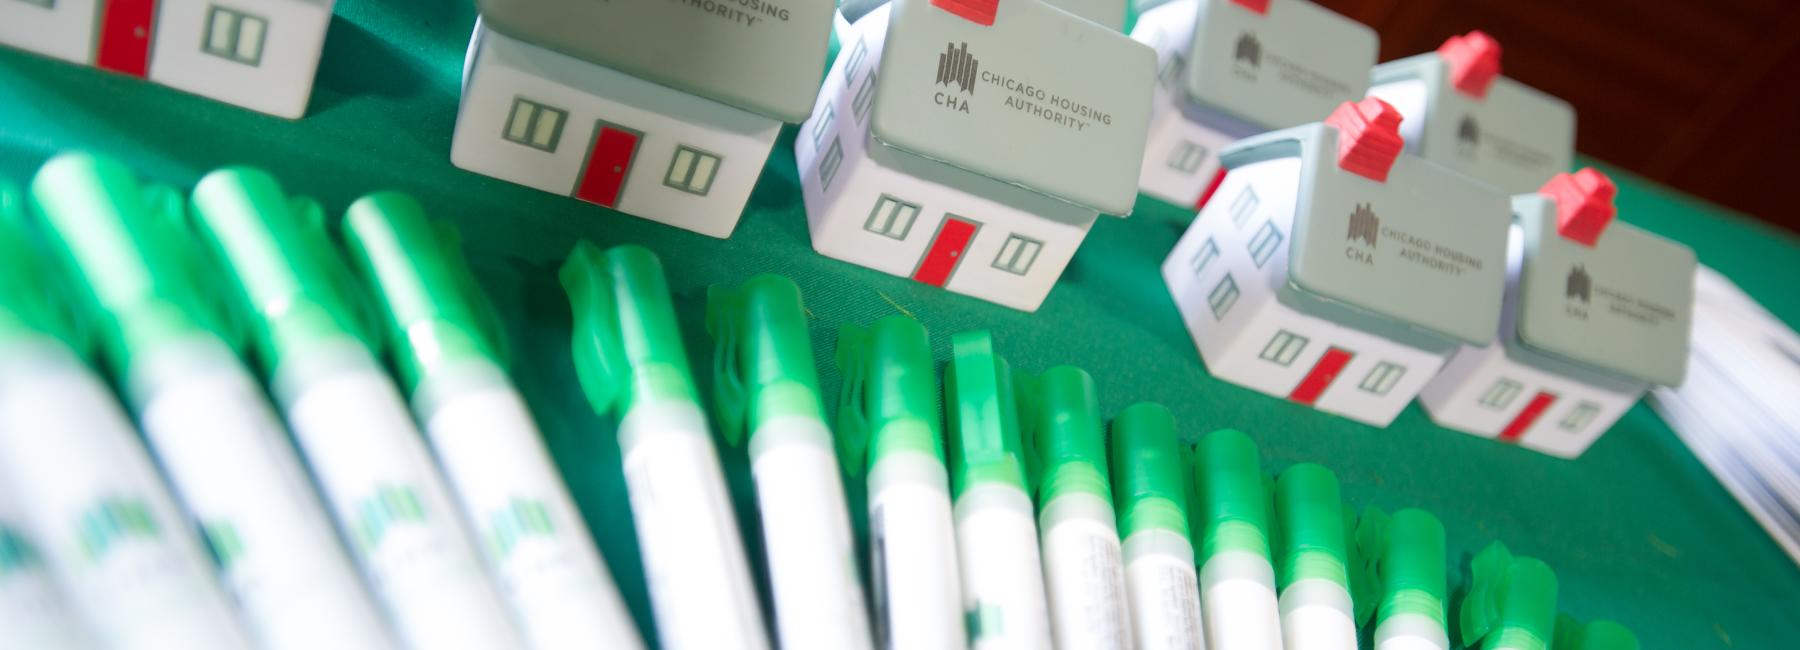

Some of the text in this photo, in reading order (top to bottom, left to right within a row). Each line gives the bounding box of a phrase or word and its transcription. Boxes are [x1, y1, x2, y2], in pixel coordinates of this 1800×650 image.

[934, 92, 970, 114] CHA
[981, 70, 1112, 125] CHICAGO HOUSING
[1004, 95, 1085, 132] AUTHORITY
[1345, 246, 1374, 267] CHA
[1381, 226, 1483, 271] CHICAGO HOUSING
[1400, 248, 1463, 277] AUTHORITY
